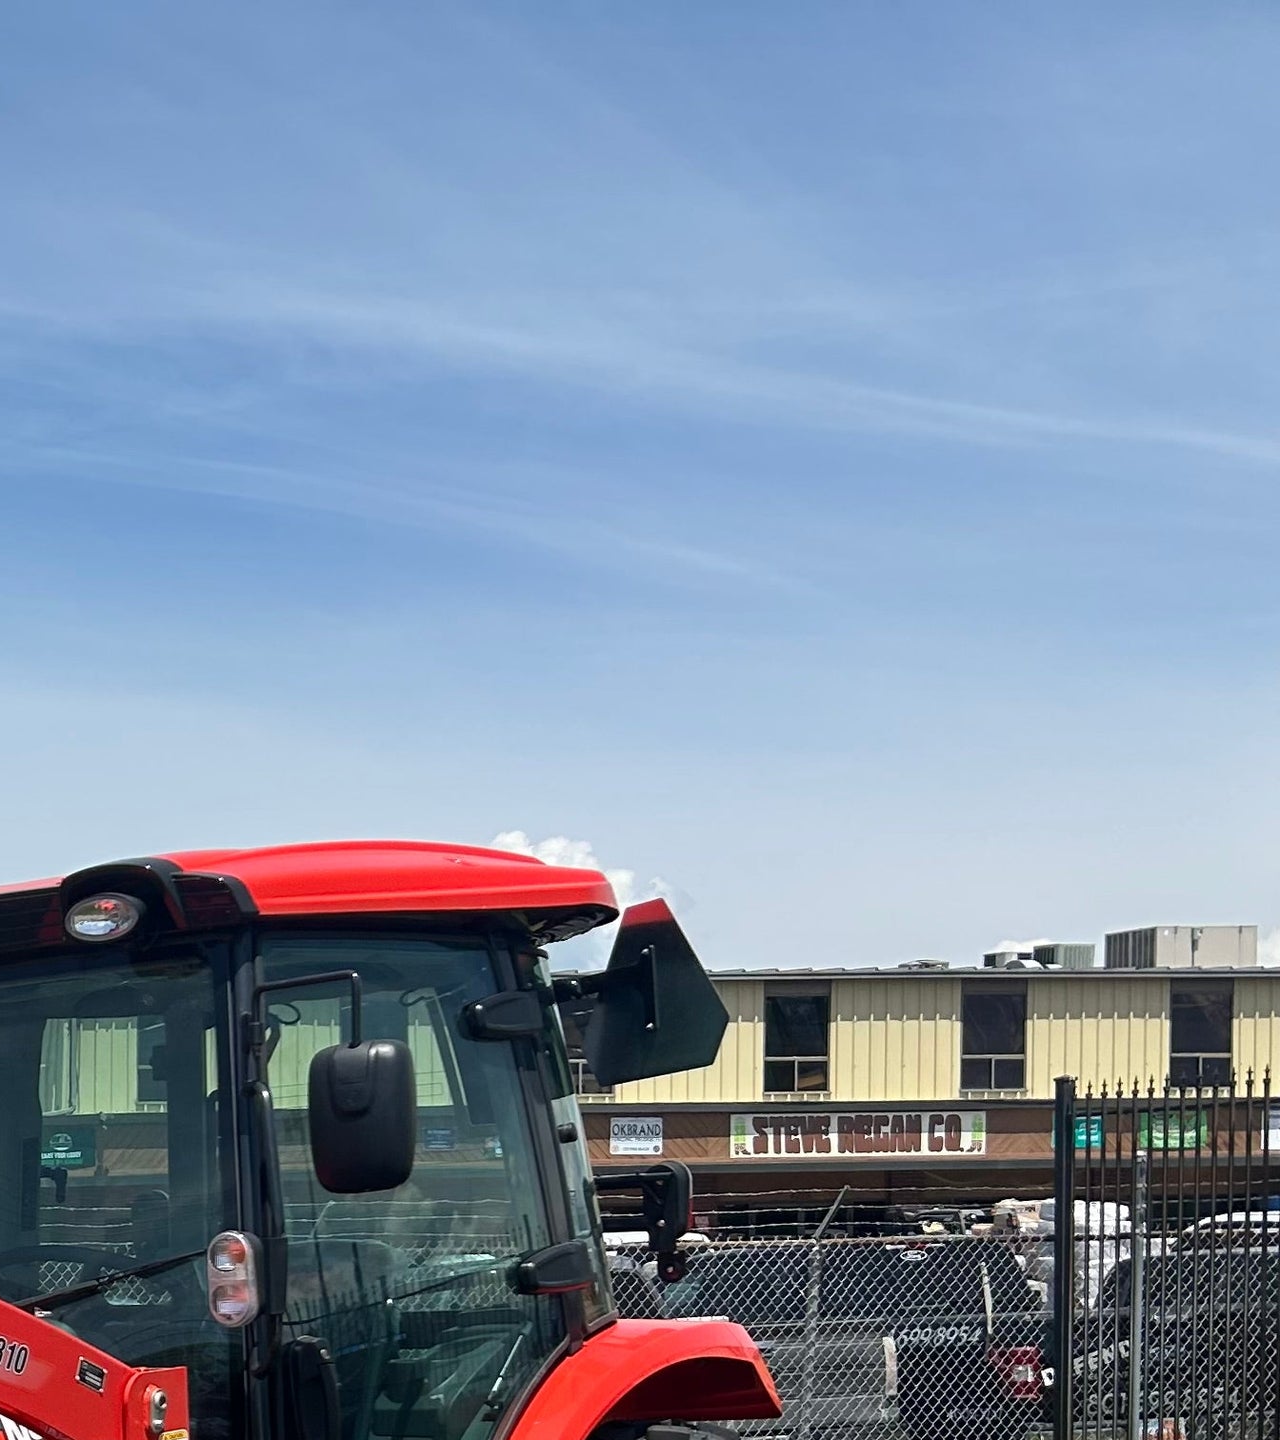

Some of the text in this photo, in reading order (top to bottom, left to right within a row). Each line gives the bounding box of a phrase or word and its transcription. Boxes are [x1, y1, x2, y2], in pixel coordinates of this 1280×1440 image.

[612, 1123, 661, 1136] OKBRAND
[752, 1114, 831, 1154] STEVE
[838, 1114, 922, 1154] REGAN
